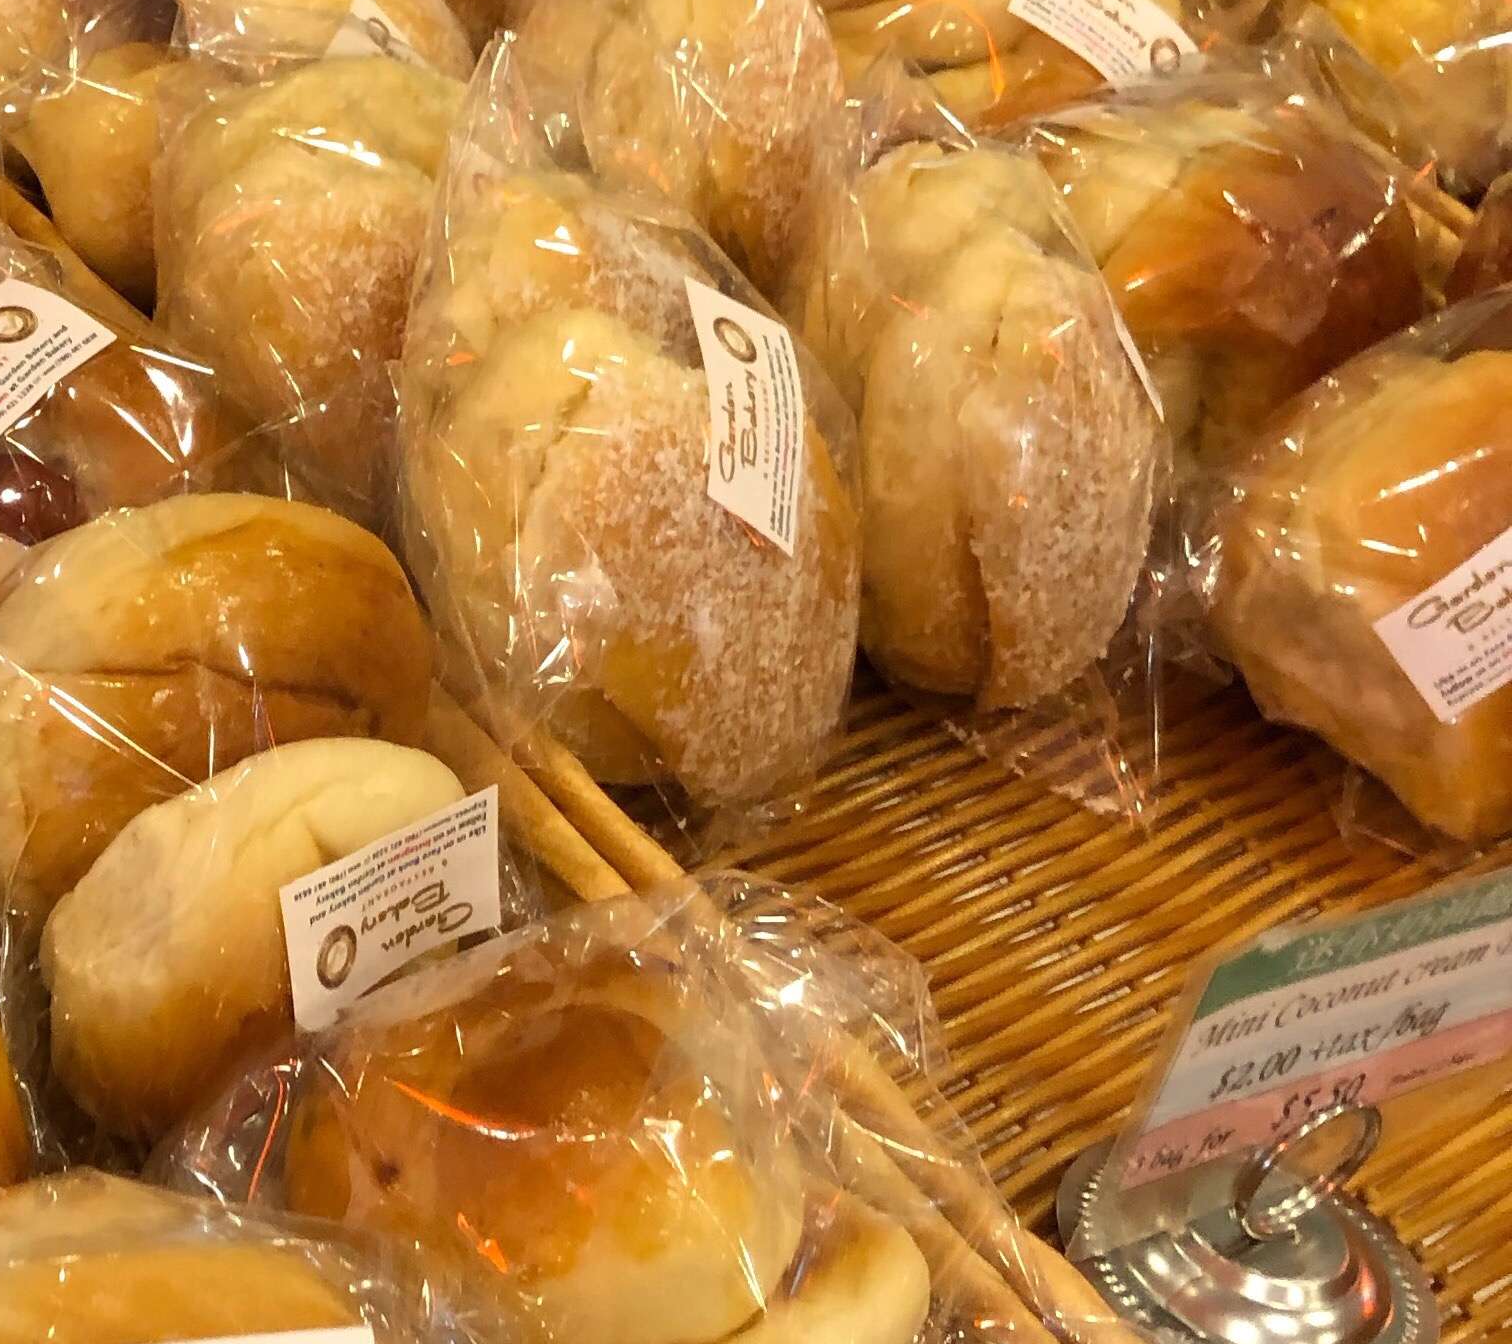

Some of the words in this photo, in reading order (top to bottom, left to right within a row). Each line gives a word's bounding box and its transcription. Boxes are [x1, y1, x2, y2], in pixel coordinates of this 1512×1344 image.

[360, 879, 451, 936] Bakery
[381, 902, 473, 952] Garden
[1209, 1043, 1302, 1099] $2.00
